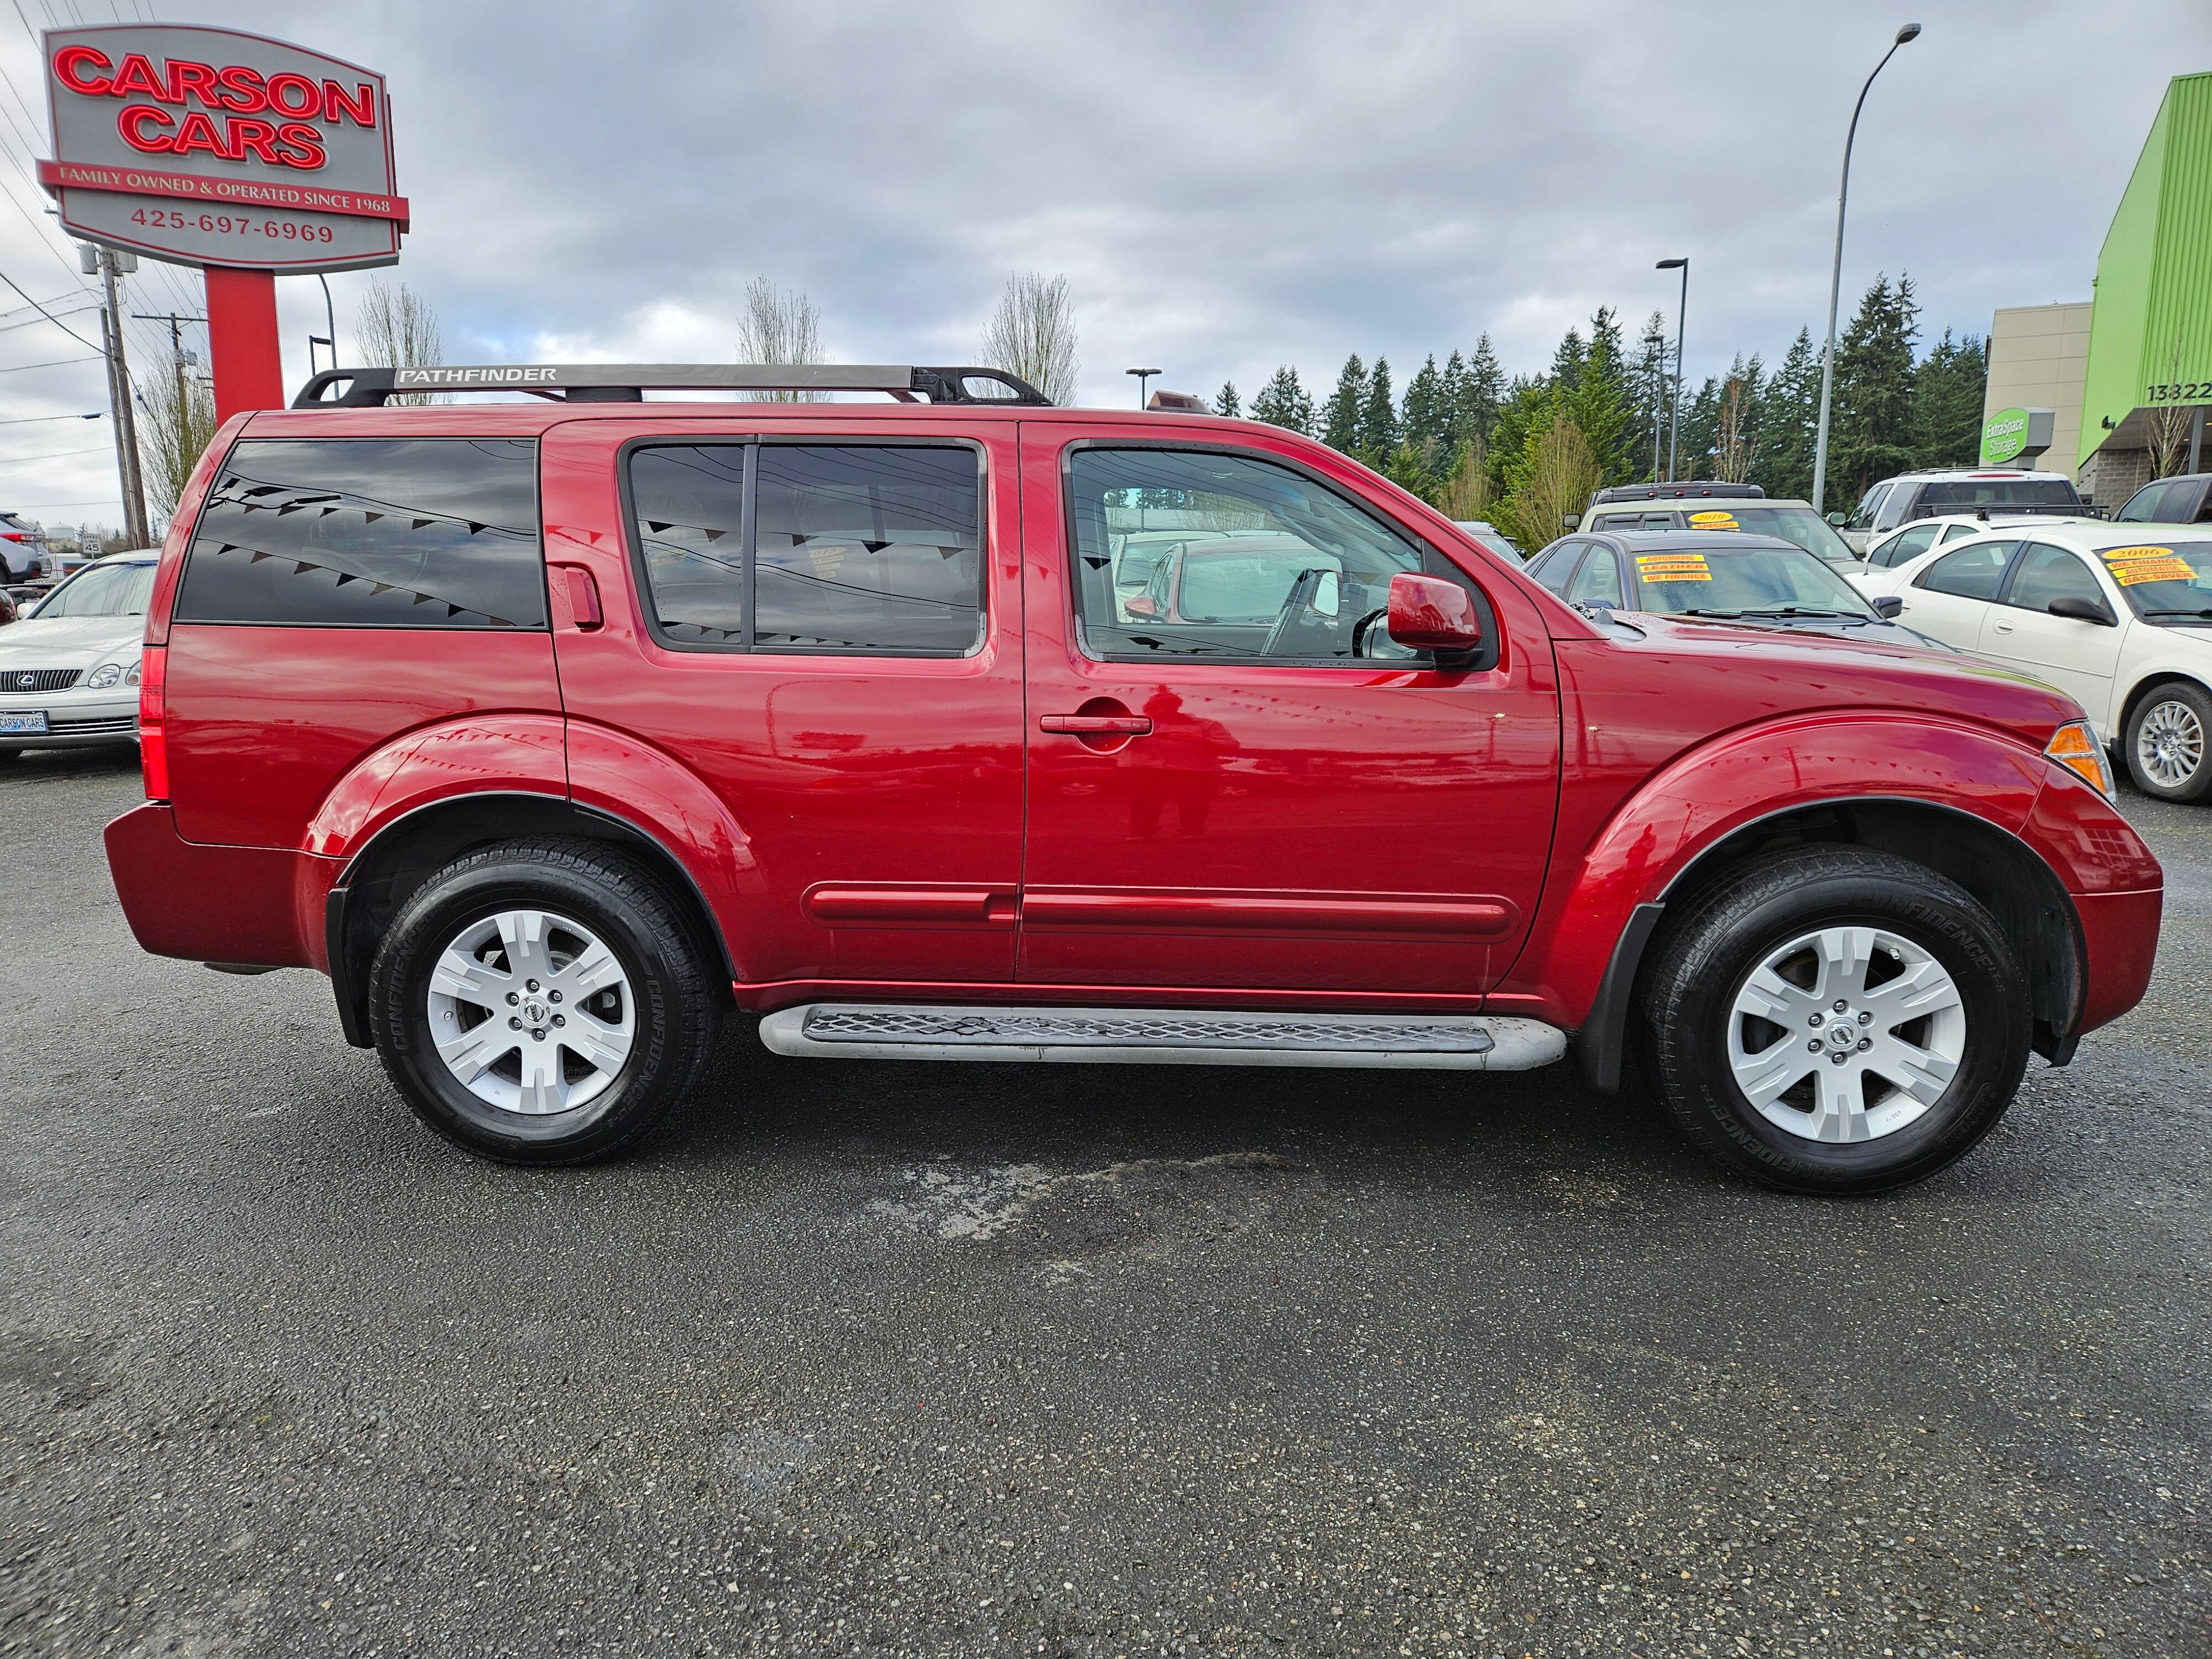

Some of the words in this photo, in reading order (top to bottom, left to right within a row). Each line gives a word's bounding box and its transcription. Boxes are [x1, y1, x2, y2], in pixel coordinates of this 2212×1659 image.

[53, 45, 376, 128] CARSON
[118, 104, 326, 170] CARS
[59, 166, 121, 185] FAMILY
[126, 174, 195, 192] OWNED
[200, 181, 213, 195] &
[216, 182, 300, 202] OPERATED
[304, 191, 350, 208] SINCE
[356, 197, 390, 213] 1968
[130, 208, 333, 243] 425-697-6969
[399, 368, 557, 383] PATHFINDER
[2147, 382, 2212, 401] 13822
[1990, 439, 2017, 457] Storage
[2116, 549, 2159, 558] 2006
[2132, 558, 2180, 566] FINANCE
[2124, 572, 2193, 584] GAS-SAVER
[2125, 565, 2180, 575] AUTOMATIC
[0, 717, 25, 728] CARSON
[26, 717, 44, 728] CARS
[1854, 893, 1994, 969] CONFIDENCE
[388, 922, 431, 1051] CONFIDENCE
[624, 979, 666, 1111] CONFIDENCE
[1711, 1105, 1849, 1182] CONFIDENCE
